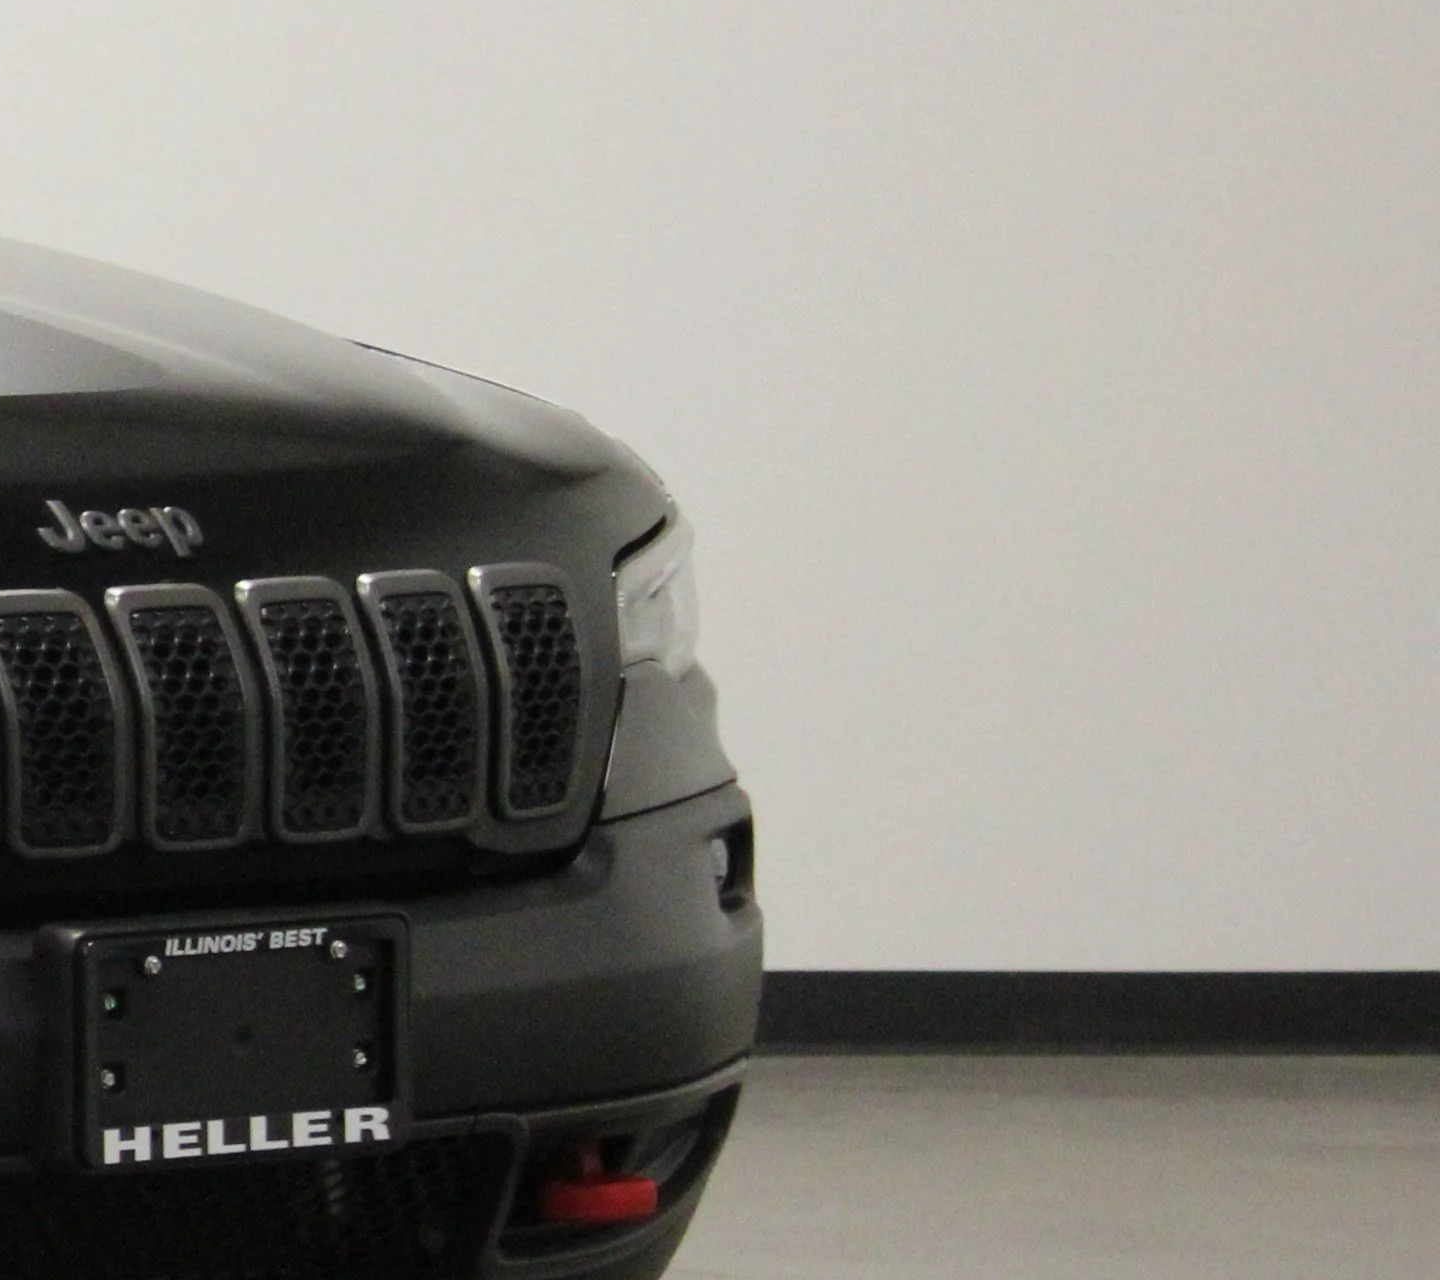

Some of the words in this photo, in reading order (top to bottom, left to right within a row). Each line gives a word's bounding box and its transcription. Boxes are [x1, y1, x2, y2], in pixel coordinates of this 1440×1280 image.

[37, 500, 204, 557] Jeep
[268, 927, 328, 950] BEST
[103, 1106, 392, 1165] HELLER
